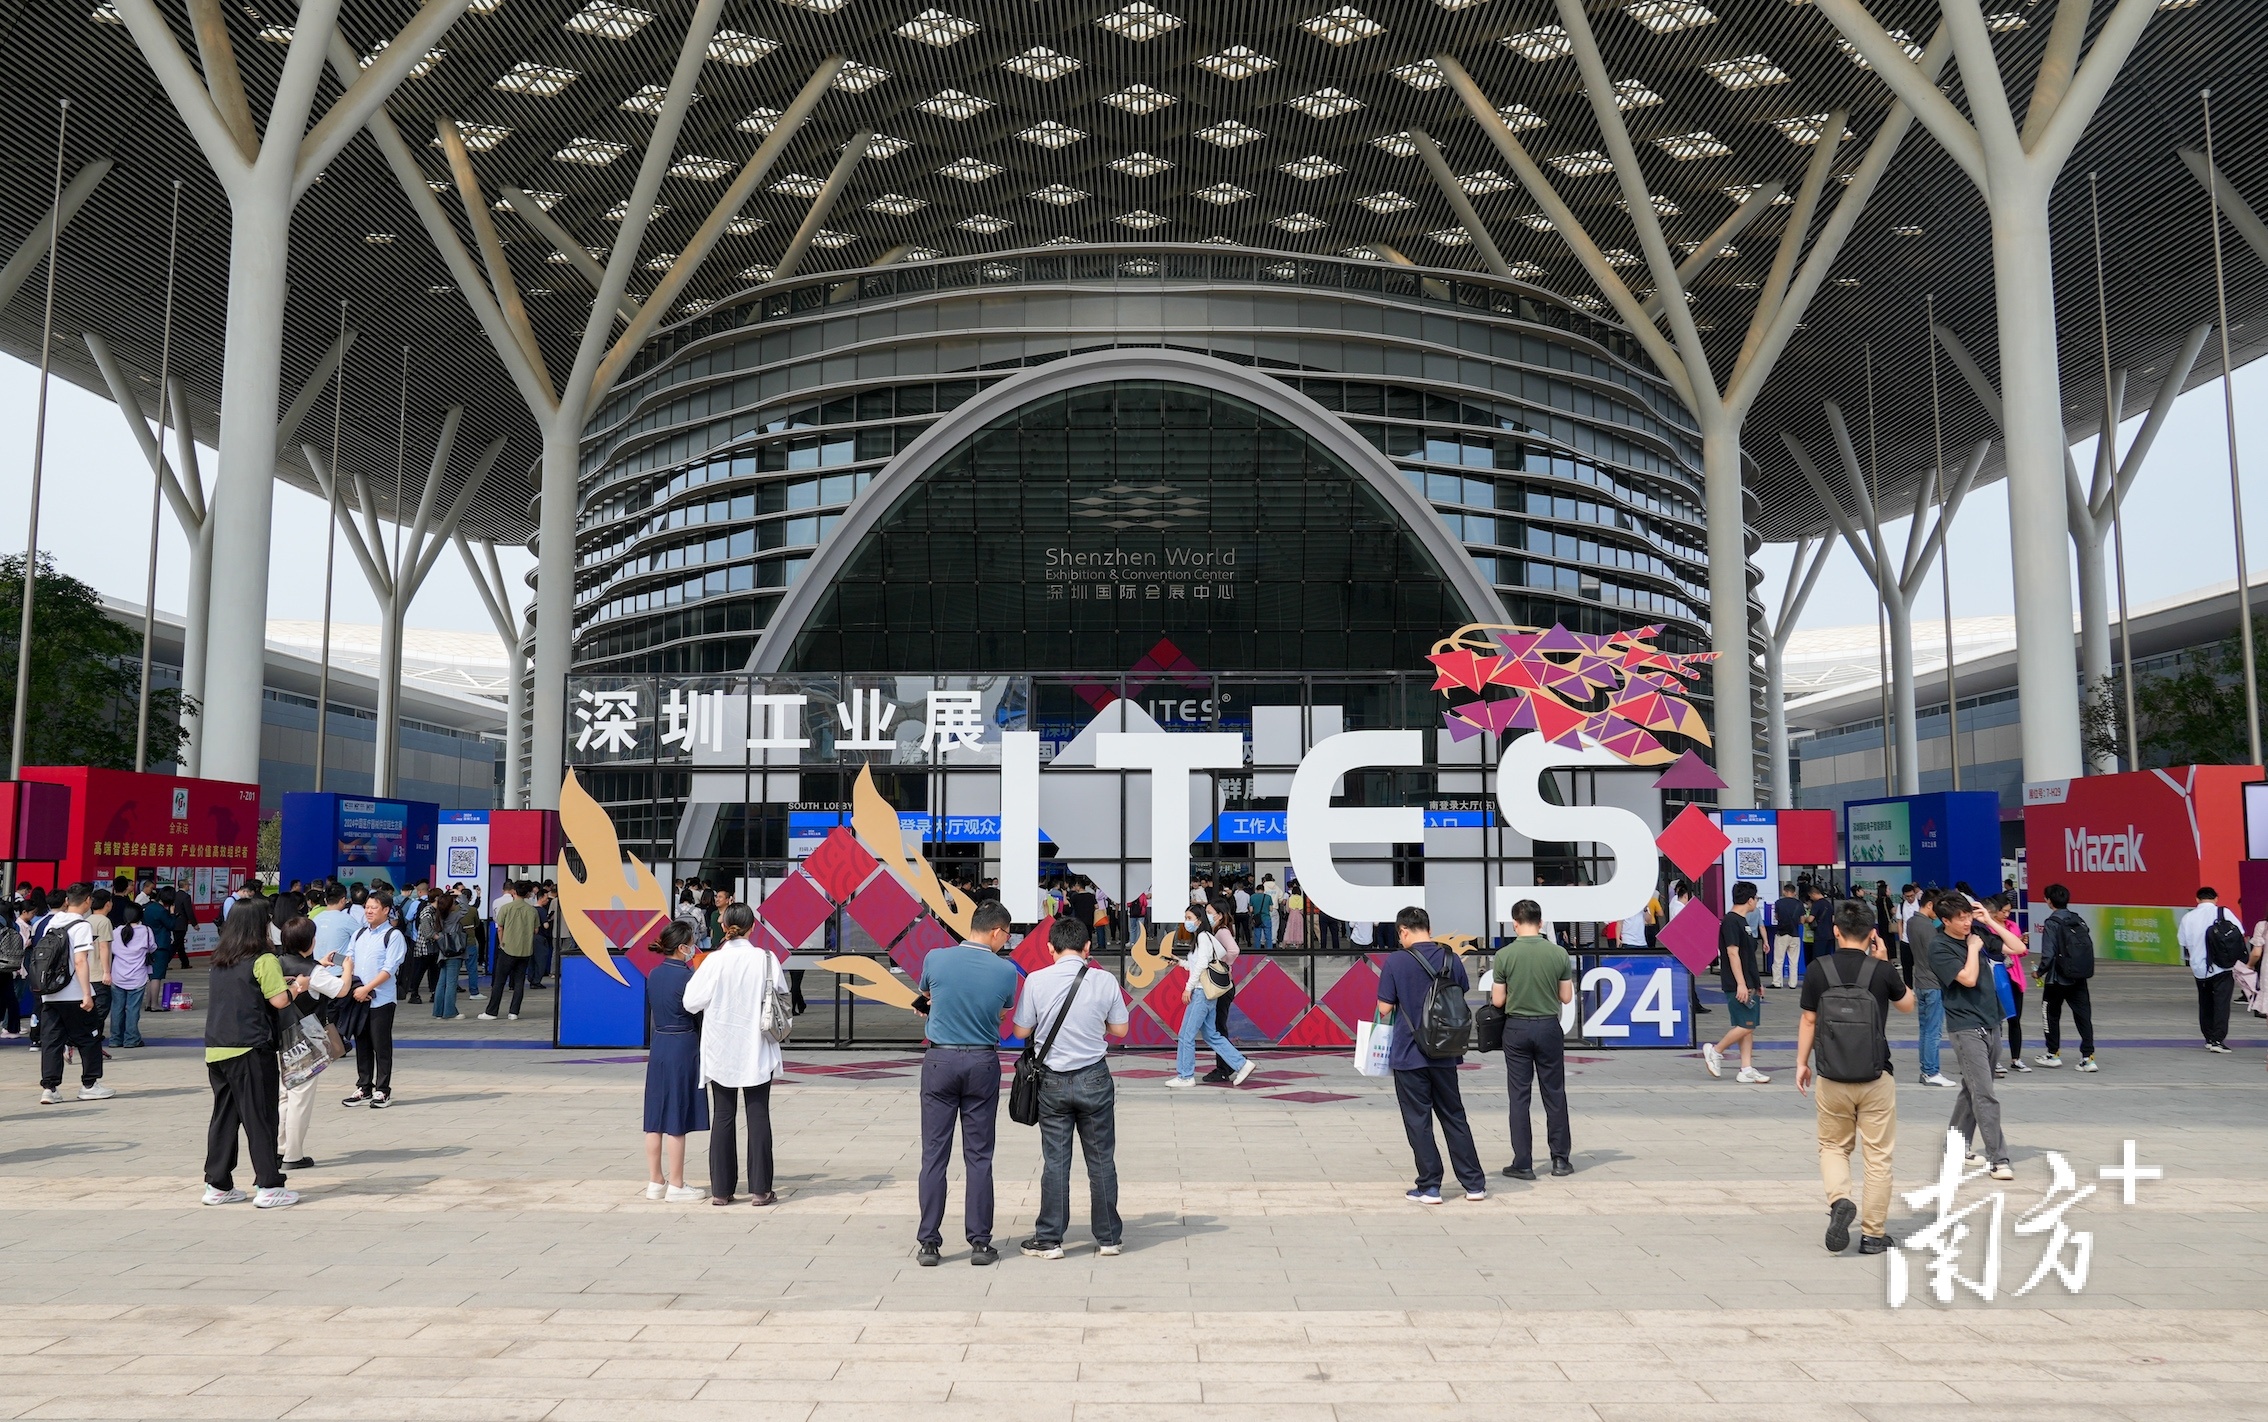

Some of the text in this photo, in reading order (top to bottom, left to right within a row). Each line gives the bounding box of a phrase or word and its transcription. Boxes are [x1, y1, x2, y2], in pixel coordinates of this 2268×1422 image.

[1045, 548, 1235, 566] Shenzhen World
[1045, 569, 1235, 580] Exhibition & Convention Center
[1047, 584, 1235, 600] 深圳国际会展中心
[574, 688, 985, 753] 深圳工业展
[239, 791, 256, 801] 7-Z01
[788, 801, 820, 811] SOUTH
[1001, 730, 1659, 925] ITES
[93, 841, 174, 857] 高端智造综合服务商
[2064, 824, 2147, 873] Mazak
